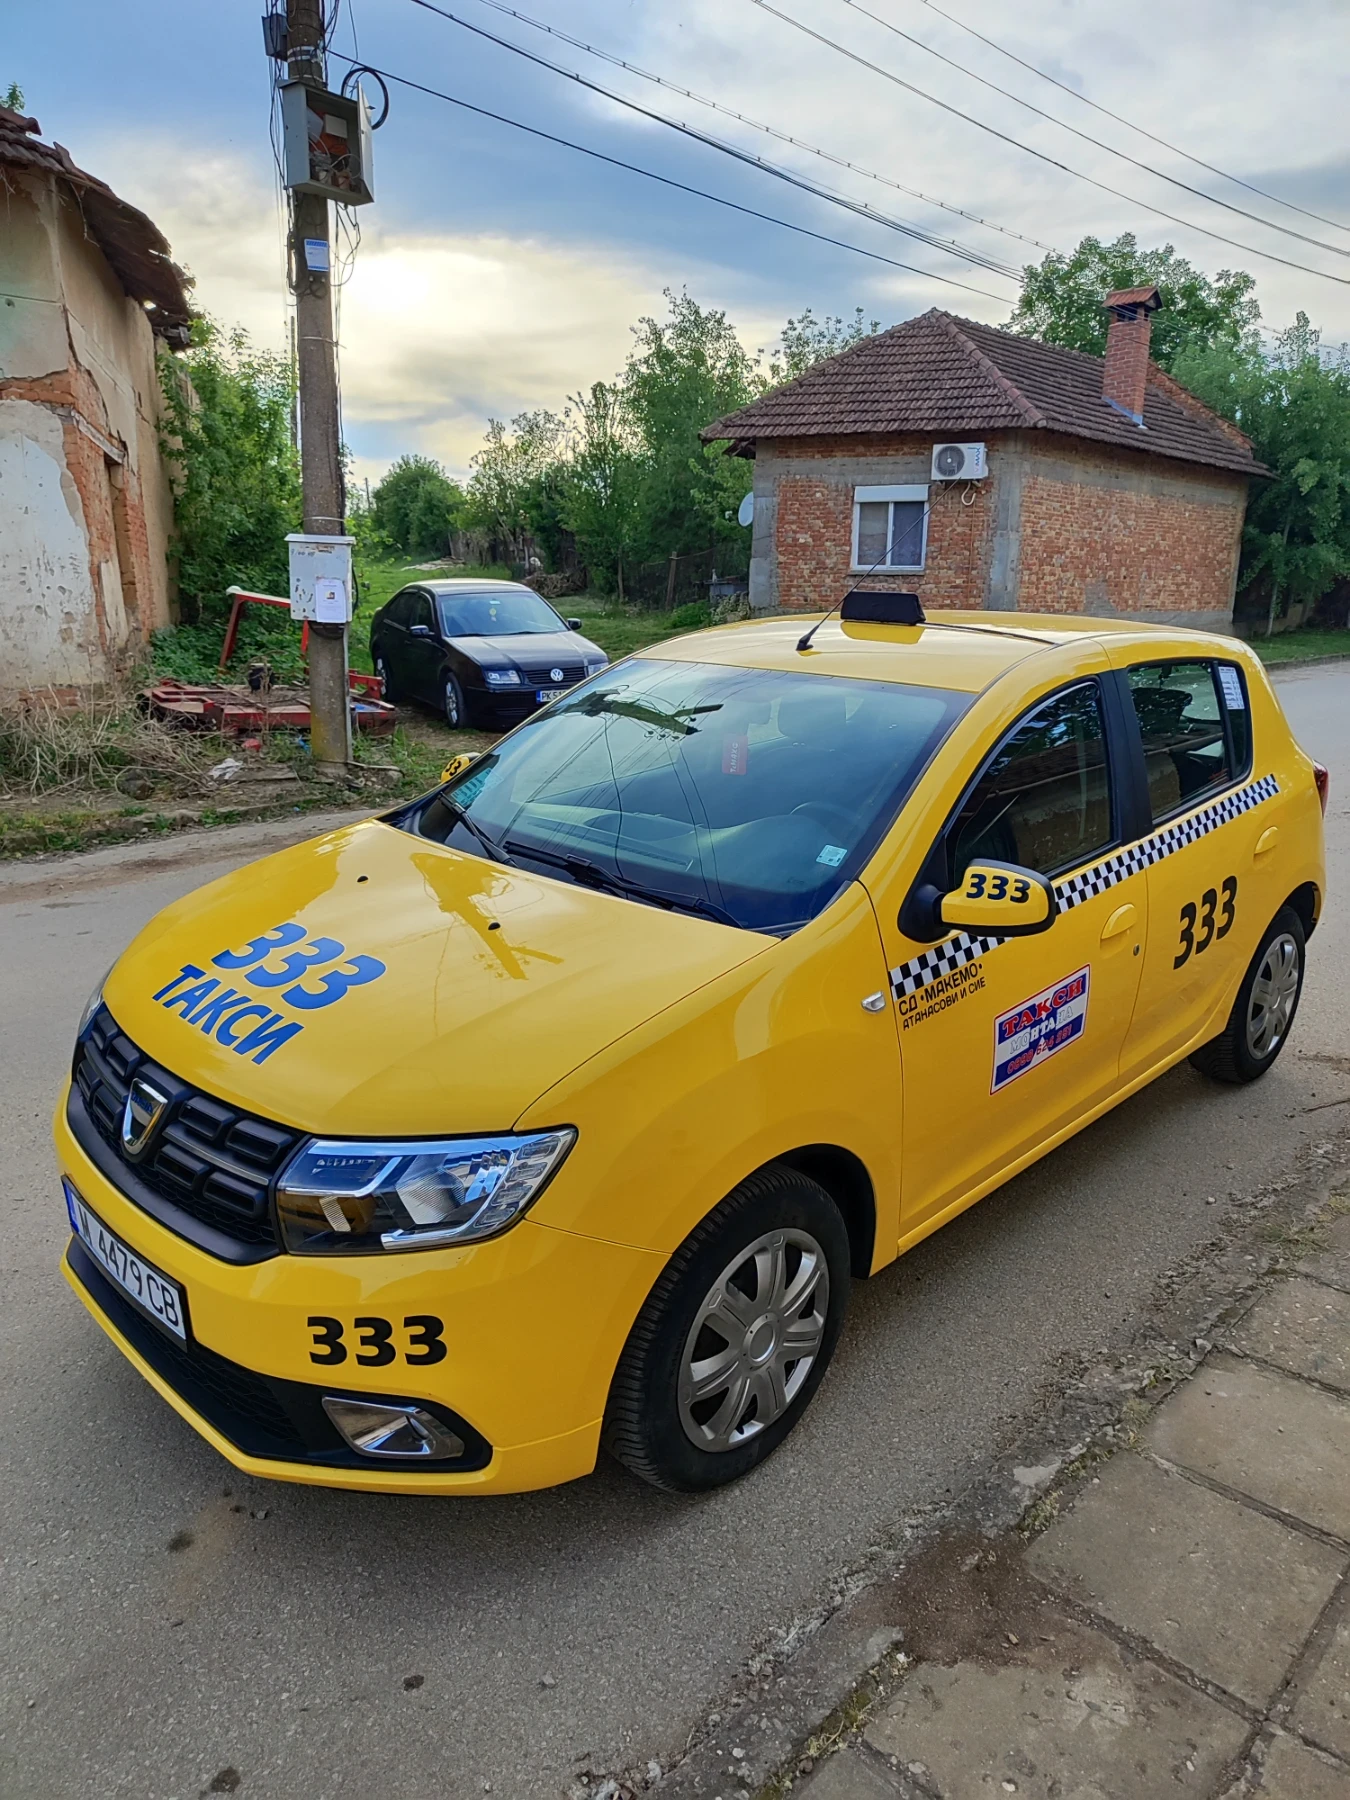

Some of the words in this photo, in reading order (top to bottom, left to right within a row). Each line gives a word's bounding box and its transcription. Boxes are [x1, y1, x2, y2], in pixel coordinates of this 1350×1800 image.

[966, 873, 1031, 904] 333
[1173, 875, 1238, 970] 333
[211, 922, 387, 1010] 333
[151, 964, 305, 1066] ТАКСИ
[898, 994, 919, 1016] СД
[902, 992, 959, 1031] АТАНАСОВИ
[960, 986, 967, 1000] И
[968, 976, 986, 994] СИЕ
[1009, 1005, 1074, 1054] МОНТАНА
[98, 1229, 142, 1298] 4479
[146, 1273, 180, 1328] CB
[307, 1314, 448, 1368] 333
